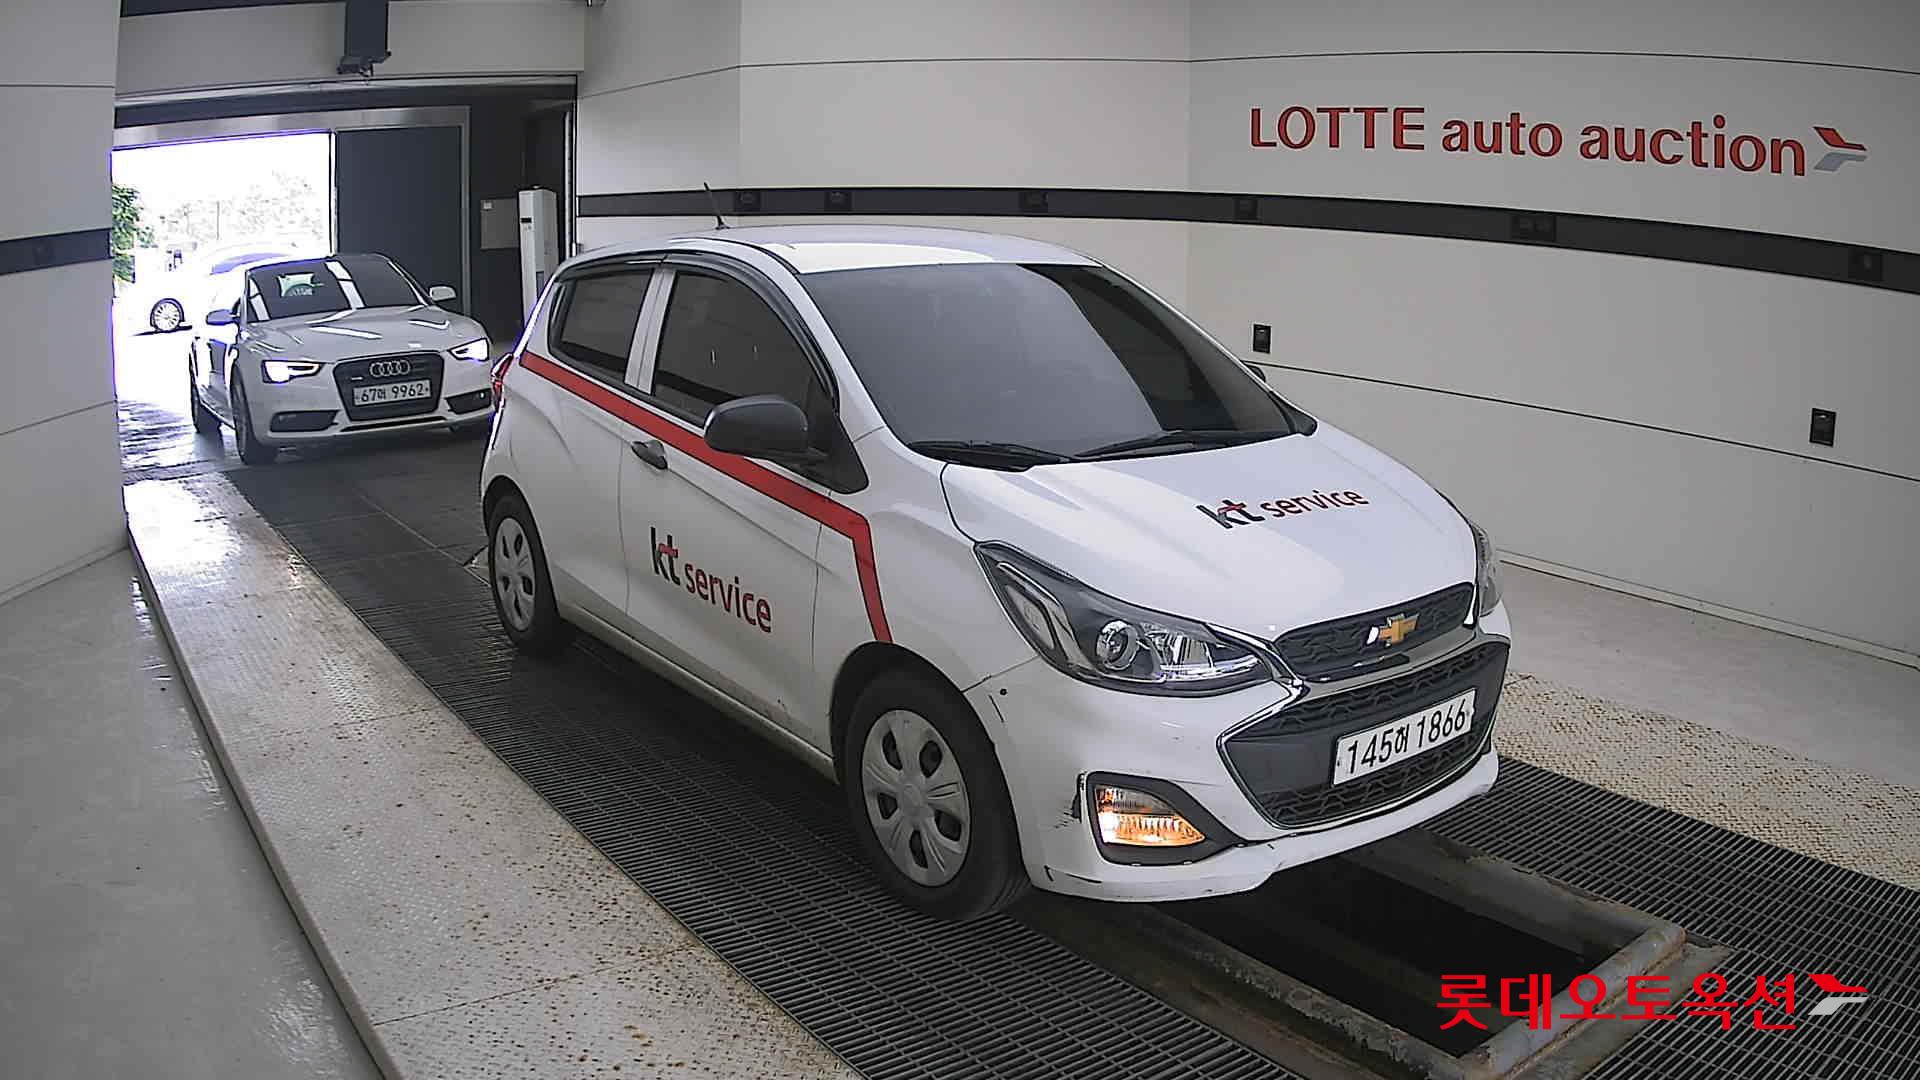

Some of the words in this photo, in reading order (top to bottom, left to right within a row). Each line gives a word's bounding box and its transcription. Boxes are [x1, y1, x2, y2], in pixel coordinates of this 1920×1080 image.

[1250, 107, 1425, 149] LOTTE
[1441, 113, 1563, 157] auto
[1579, 115, 1805, 177] auction
[391, 383, 424, 399] 9962
[1196, 499, 1266, 529] kt
[1260, 489, 1370, 518] service
[650, 526, 680, 585] kt
[684, 563, 771, 632] service
[1348, 724, 1409, 774] 145허
[1417, 699, 1466, 748] 1866
